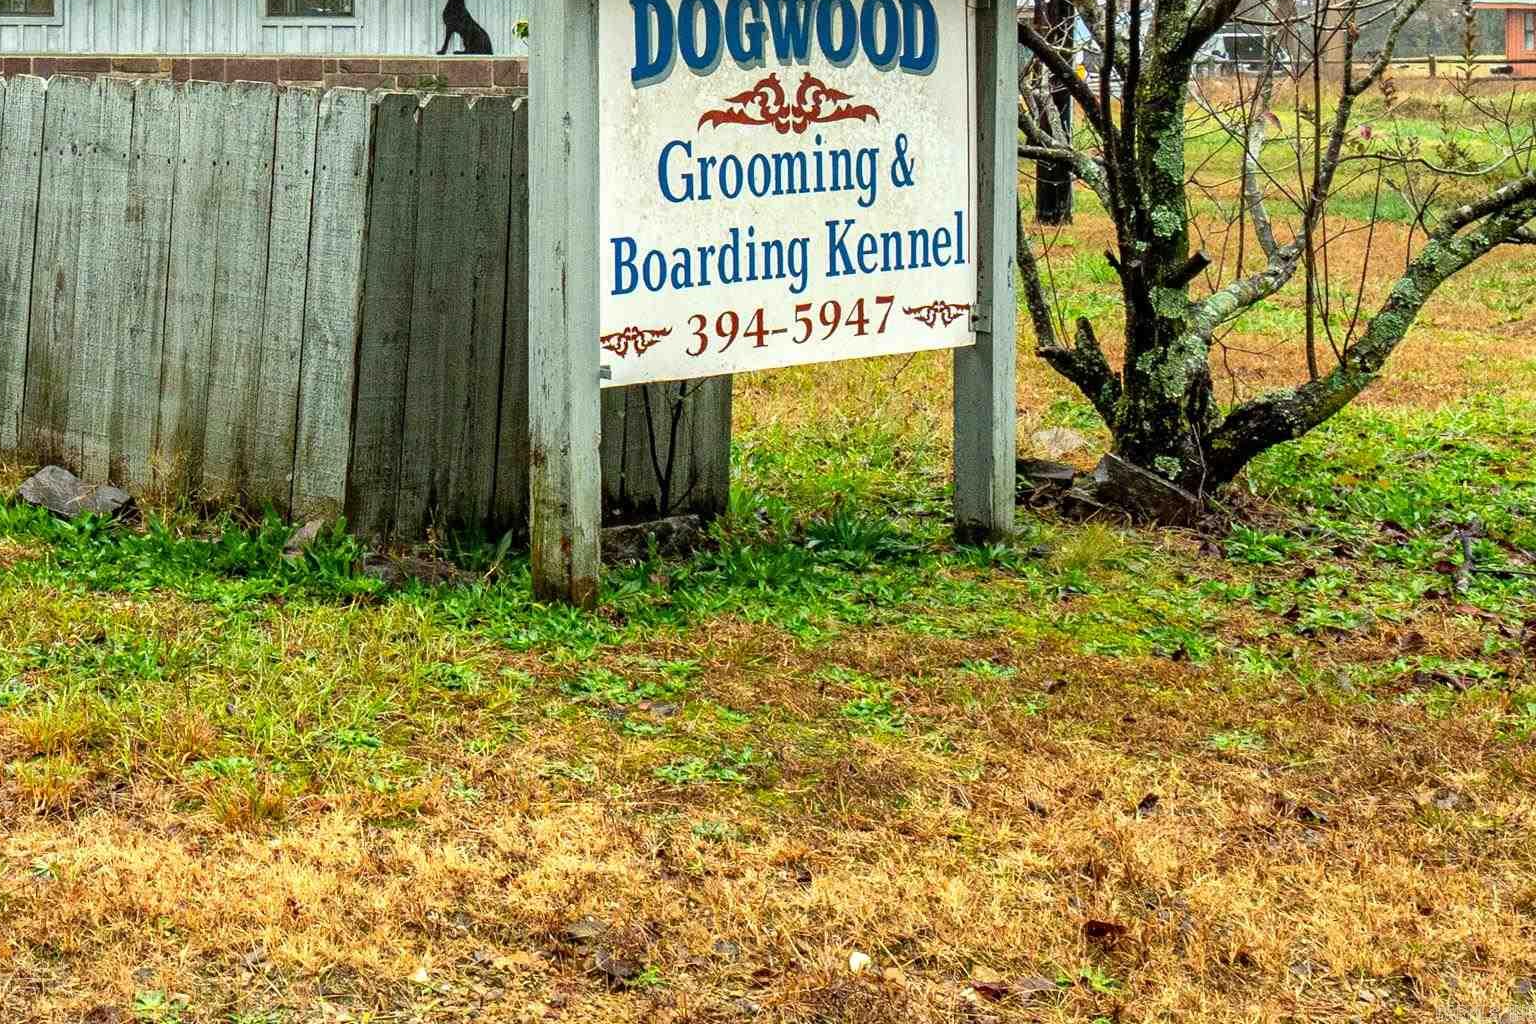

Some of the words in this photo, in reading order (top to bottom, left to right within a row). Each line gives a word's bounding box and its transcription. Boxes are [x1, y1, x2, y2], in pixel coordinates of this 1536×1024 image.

[658, 134, 880, 207] Grooming
[889, 133, 916, 188] &
[610, 225, 811, 296] Boarding
[824, 210, 966, 278] Kennel
[686, 295, 896, 357] 394-5947
